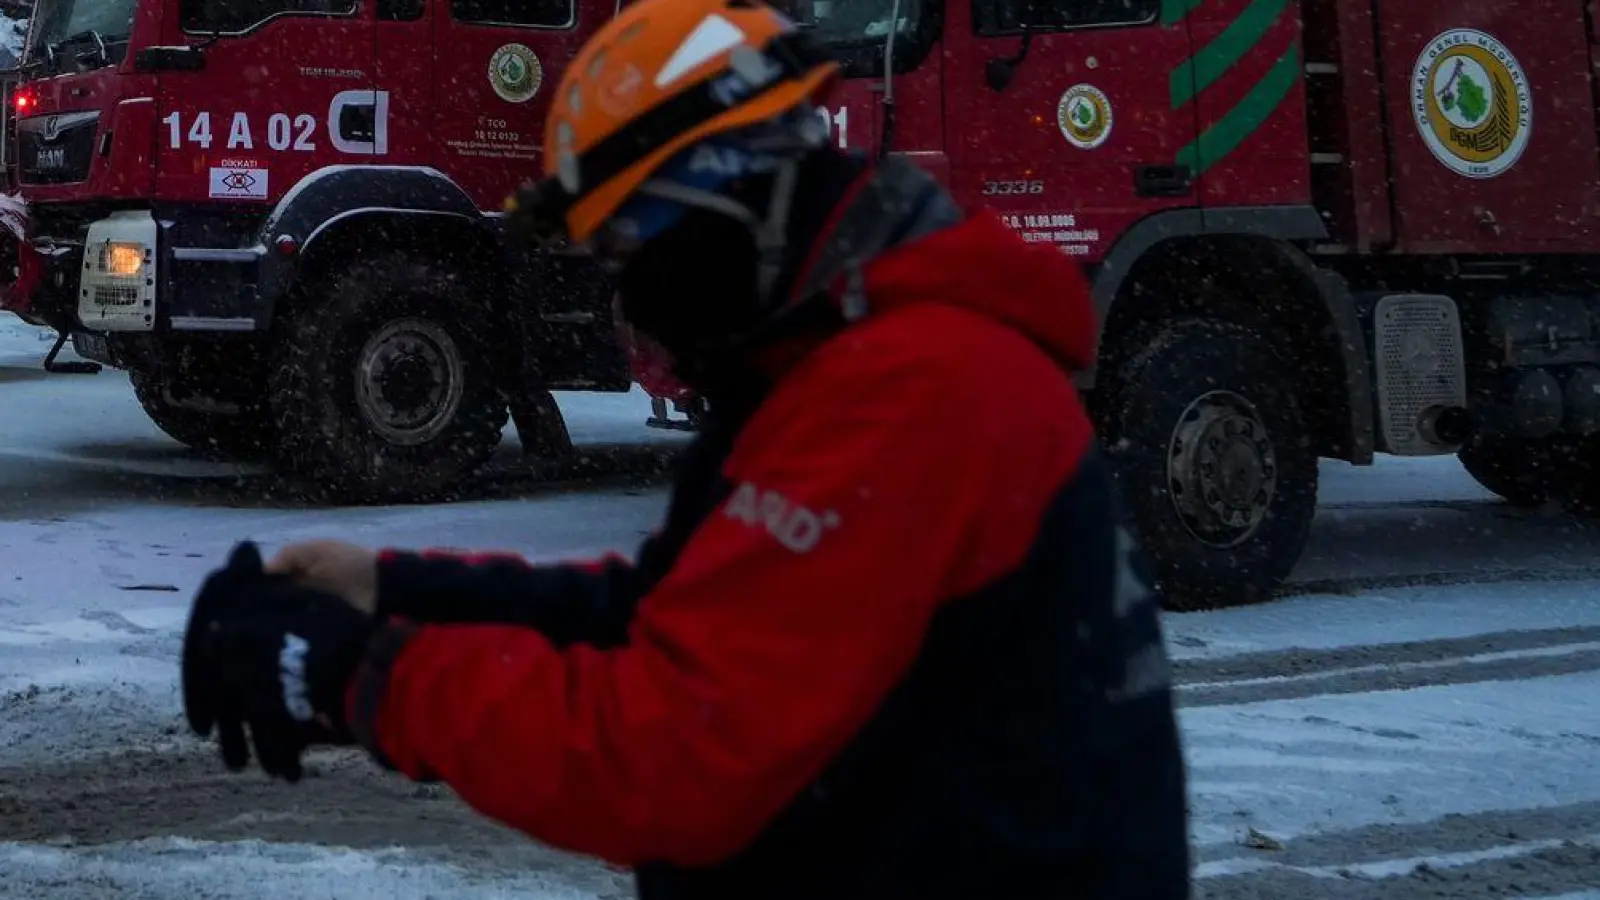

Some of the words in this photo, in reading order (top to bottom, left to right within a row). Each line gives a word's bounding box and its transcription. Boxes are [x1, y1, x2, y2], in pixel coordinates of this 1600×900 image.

[1428, 34, 1468, 59] GENEL
[162, 111, 213, 149] 14
[227, 111, 253, 149] A
[267, 112, 317, 151] 02
[981, 180, 1045, 195] 3336
